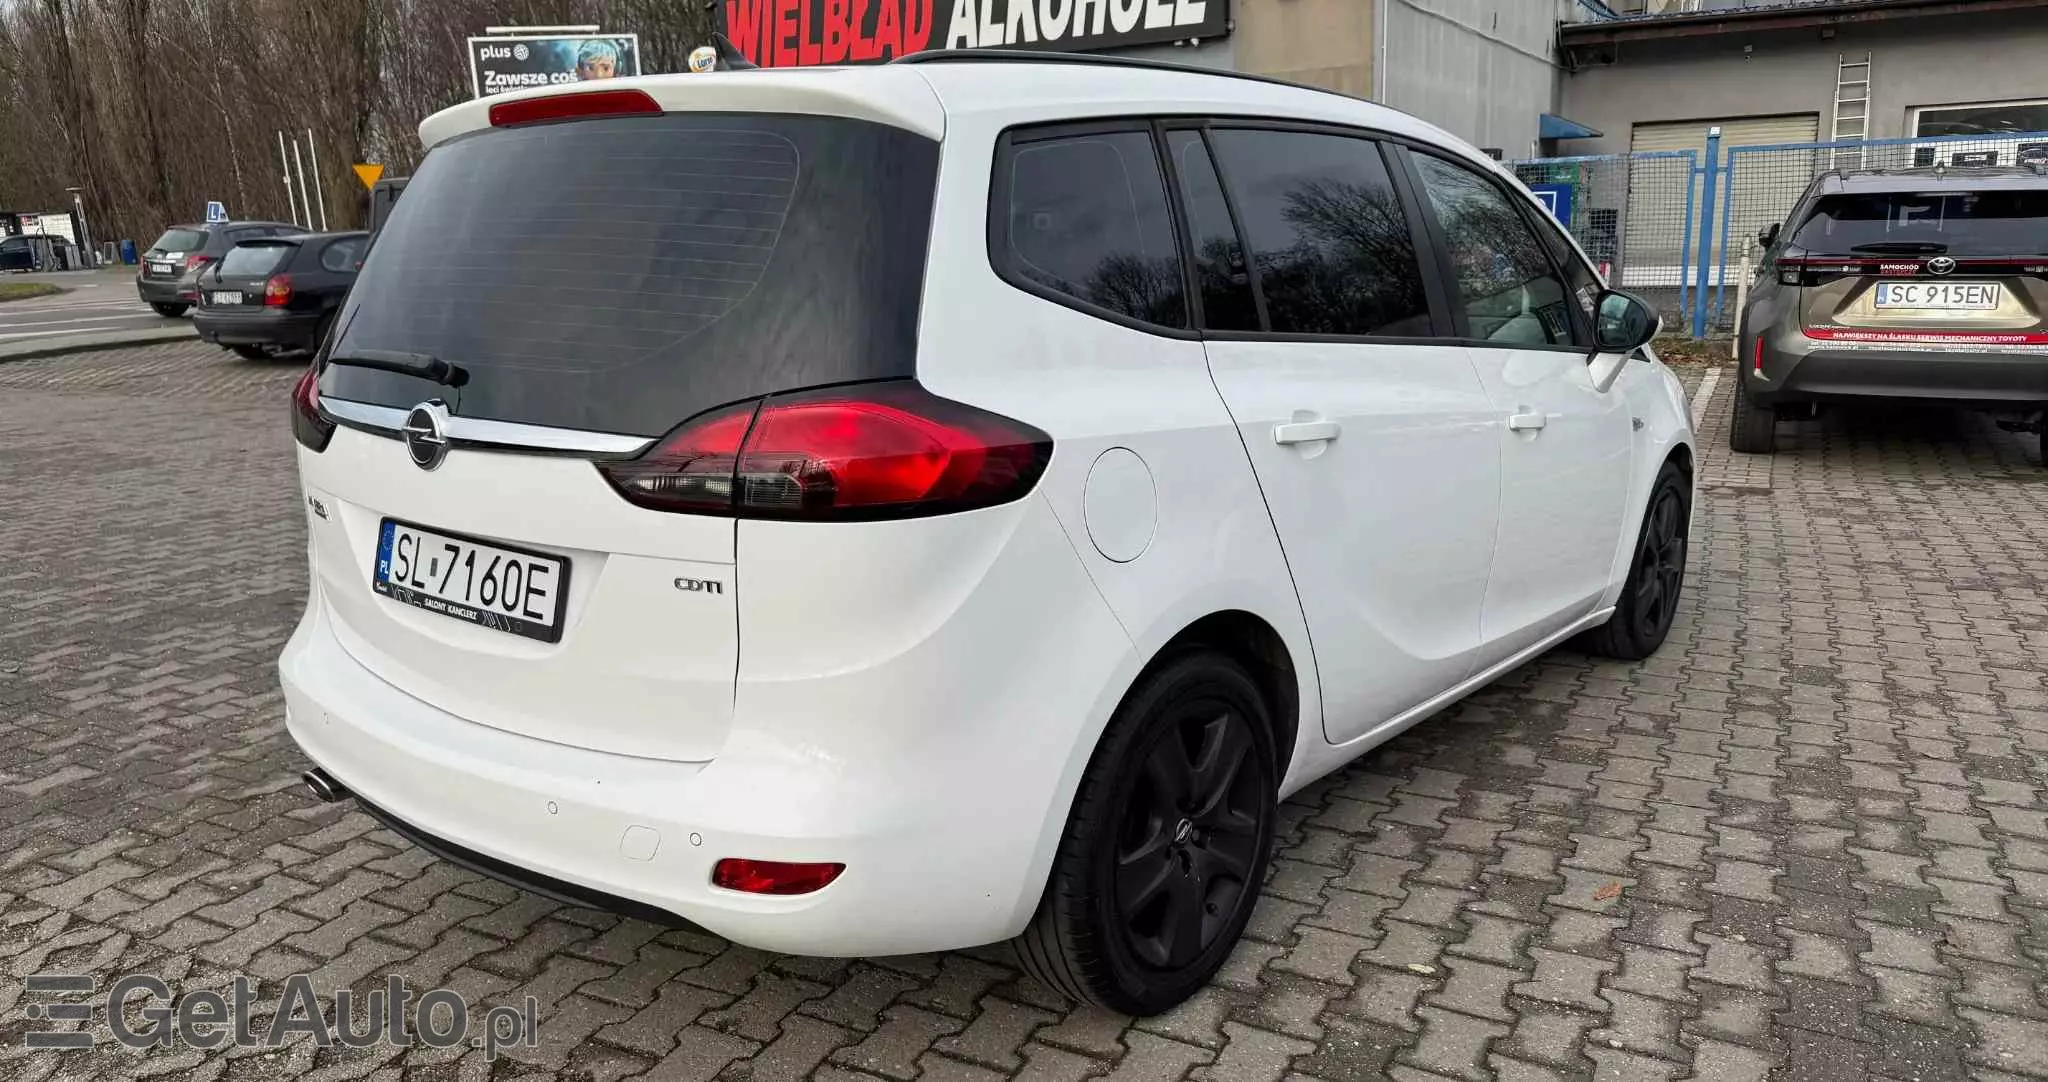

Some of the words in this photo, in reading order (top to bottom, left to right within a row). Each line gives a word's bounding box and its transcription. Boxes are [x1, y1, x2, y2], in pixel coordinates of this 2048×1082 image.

[480, 44, 511, 61] plus
[484, 70, 548, 86] Zawsze
[550, 68, 578, 84] coś
[211, 204, 217, 219] L
[1891, 285, 1918, 303] SC
[1926, 286, 1994, 304] 915EN
[380, 559, 389, 574] PL
[395, 533, 425, 589] SL
[438, 543, 550, 620] 7160E
[424, 598, 446, 611] SALONY
[447, 604, 477, 620] KANCLERZ
